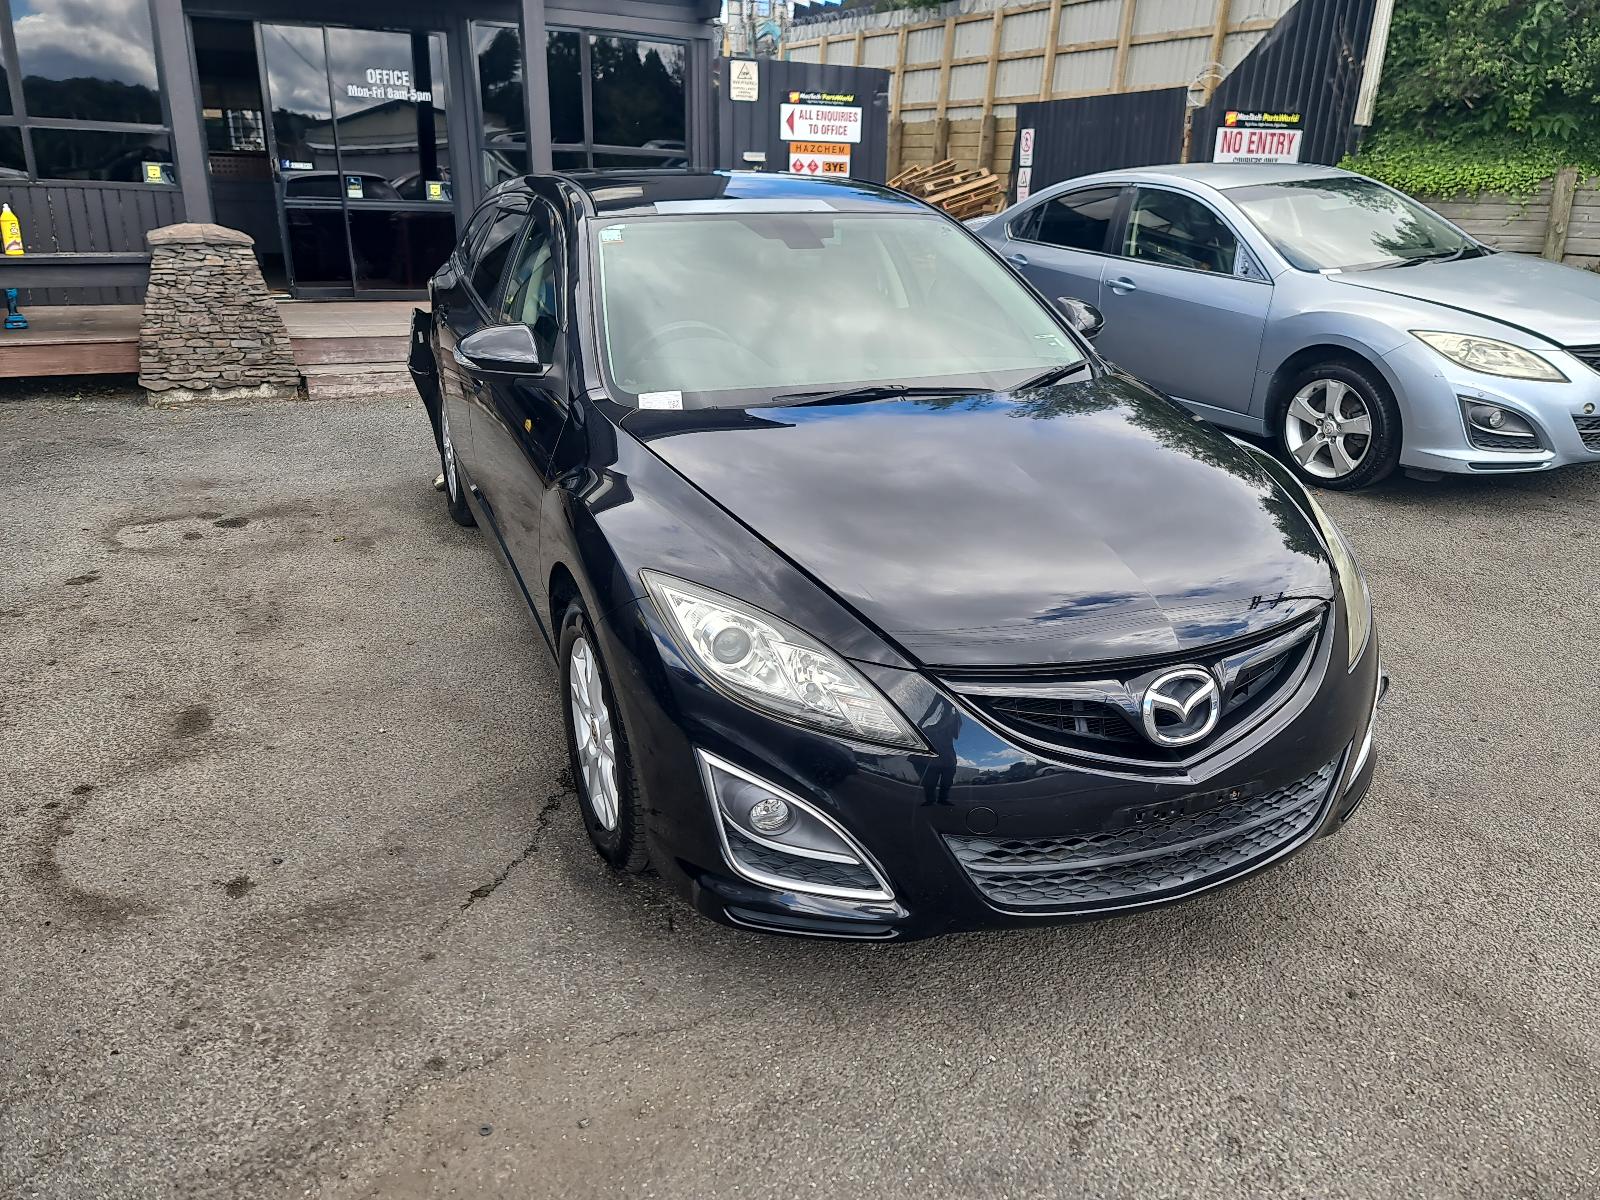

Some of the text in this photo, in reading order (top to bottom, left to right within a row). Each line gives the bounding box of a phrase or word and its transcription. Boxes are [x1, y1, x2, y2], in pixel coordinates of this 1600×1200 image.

[366, 68, 410, 86] OFFICE
[347, 84, 432, 103] Mon-Fri 8am-5pm
[799, 109, 858, 122] ALL ENQUIRIES
[808, 124, 848, 136] TO OFFICE
[795, 143, 845, 154] HAZCHEM
[1220, 130, 1296, 155] NO ENTRY
[825, 162, 845, 172] 3YE
